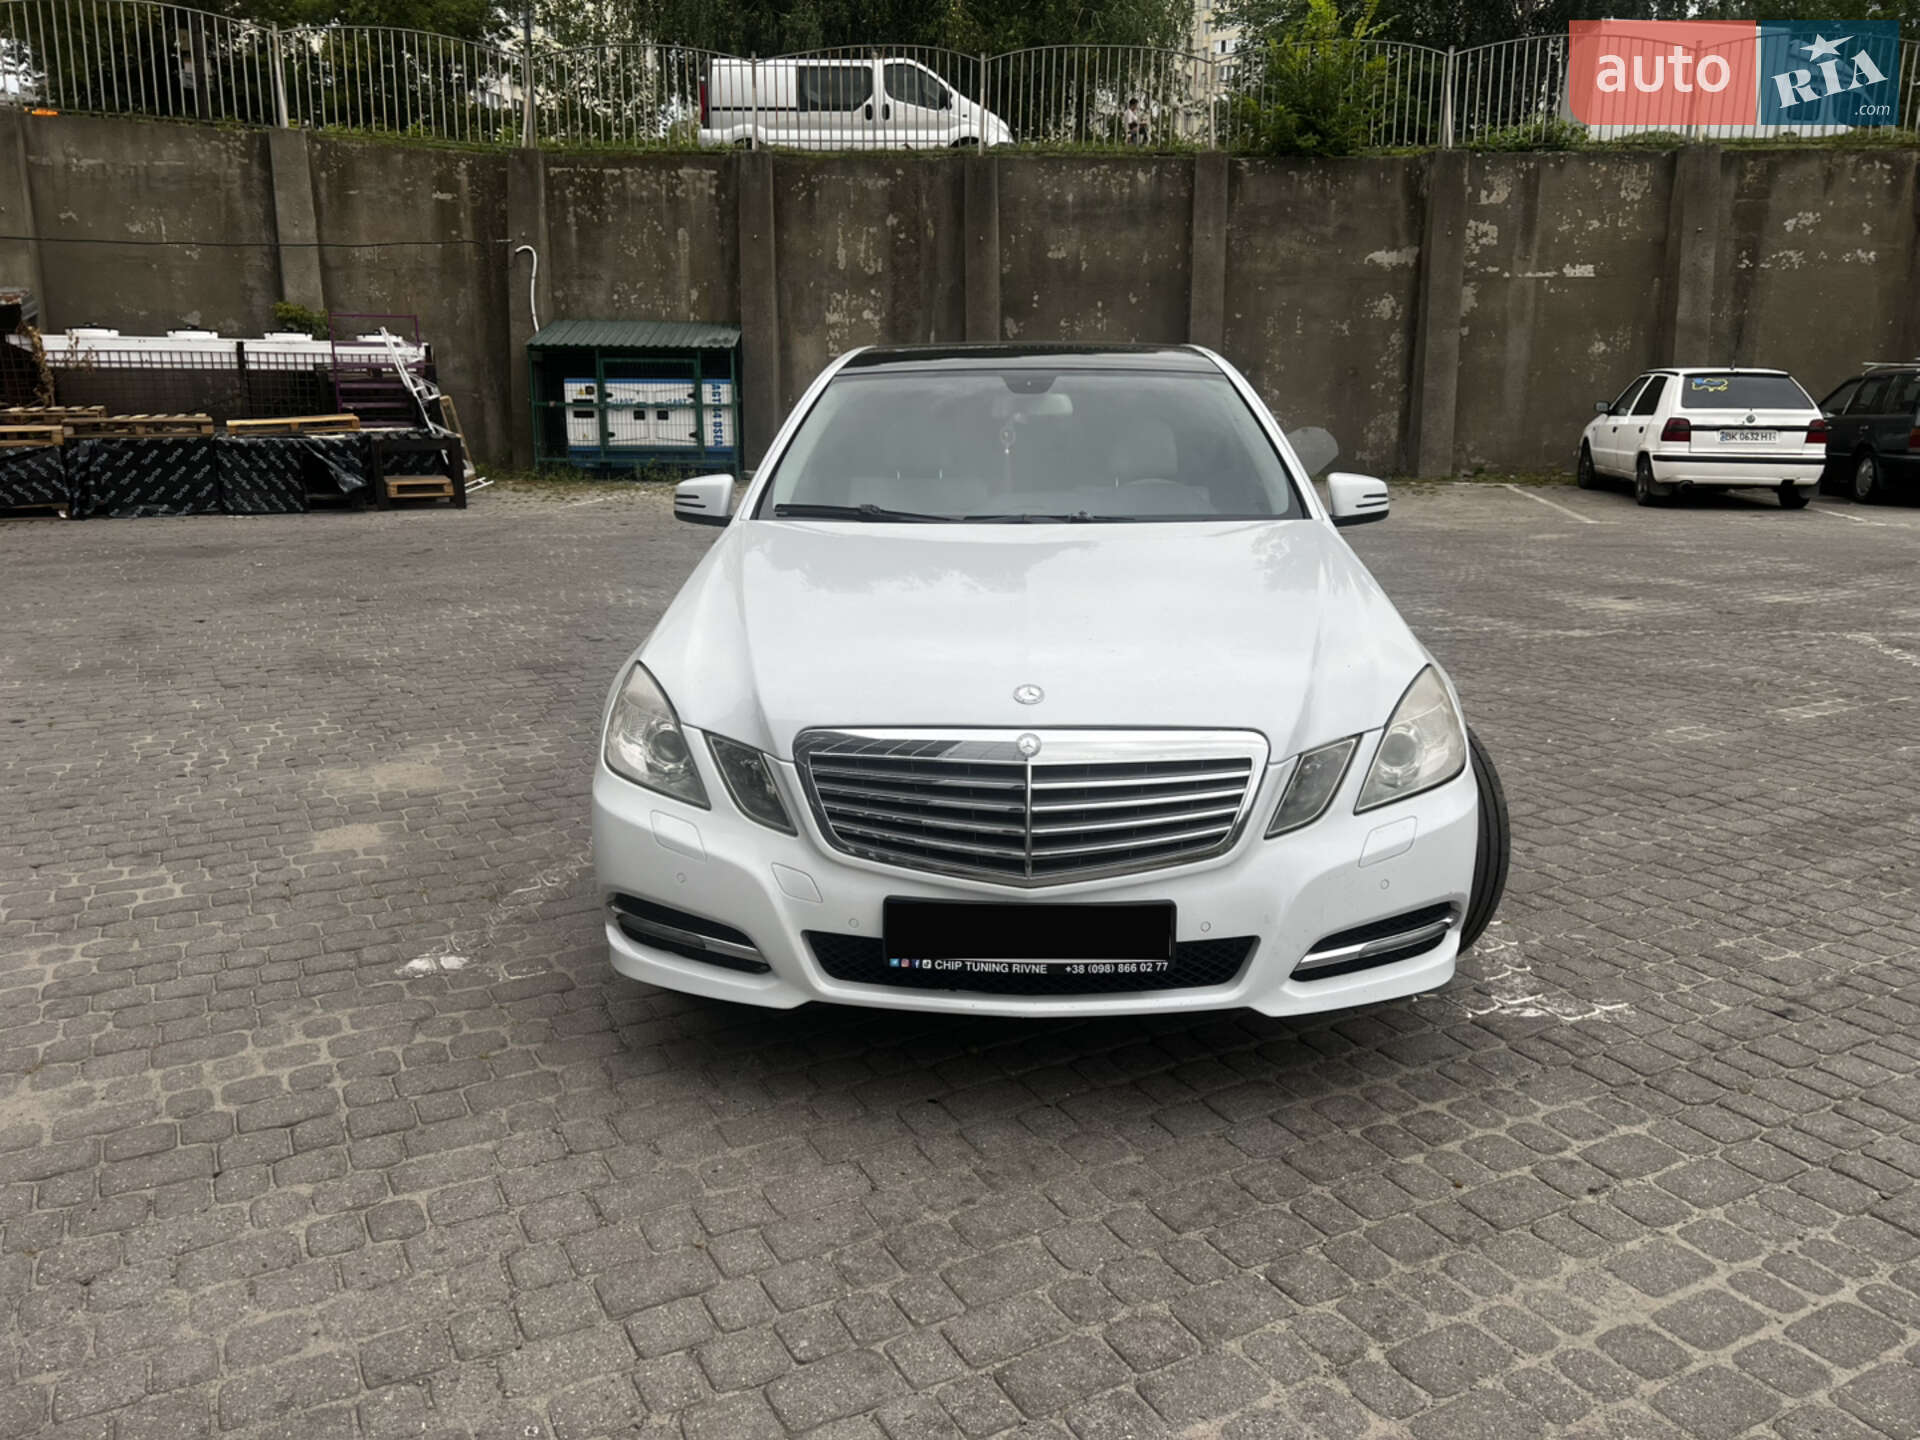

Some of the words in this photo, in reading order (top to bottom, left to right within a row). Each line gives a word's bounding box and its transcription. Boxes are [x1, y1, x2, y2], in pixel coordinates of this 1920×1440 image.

[934, 959, 962, 970] CHIP
[965, 961, 1009, 973] TUNING
[1012, 963, 1048, 974] RIVNE
[1065, 964, 1085, 974] +38
[1087, 964, 1115, 974] (098)
[1117, 963, 1137, 973] 866
[1139, 962, 1152, 972] 02
[1155, 962, 1168, 971] 77
